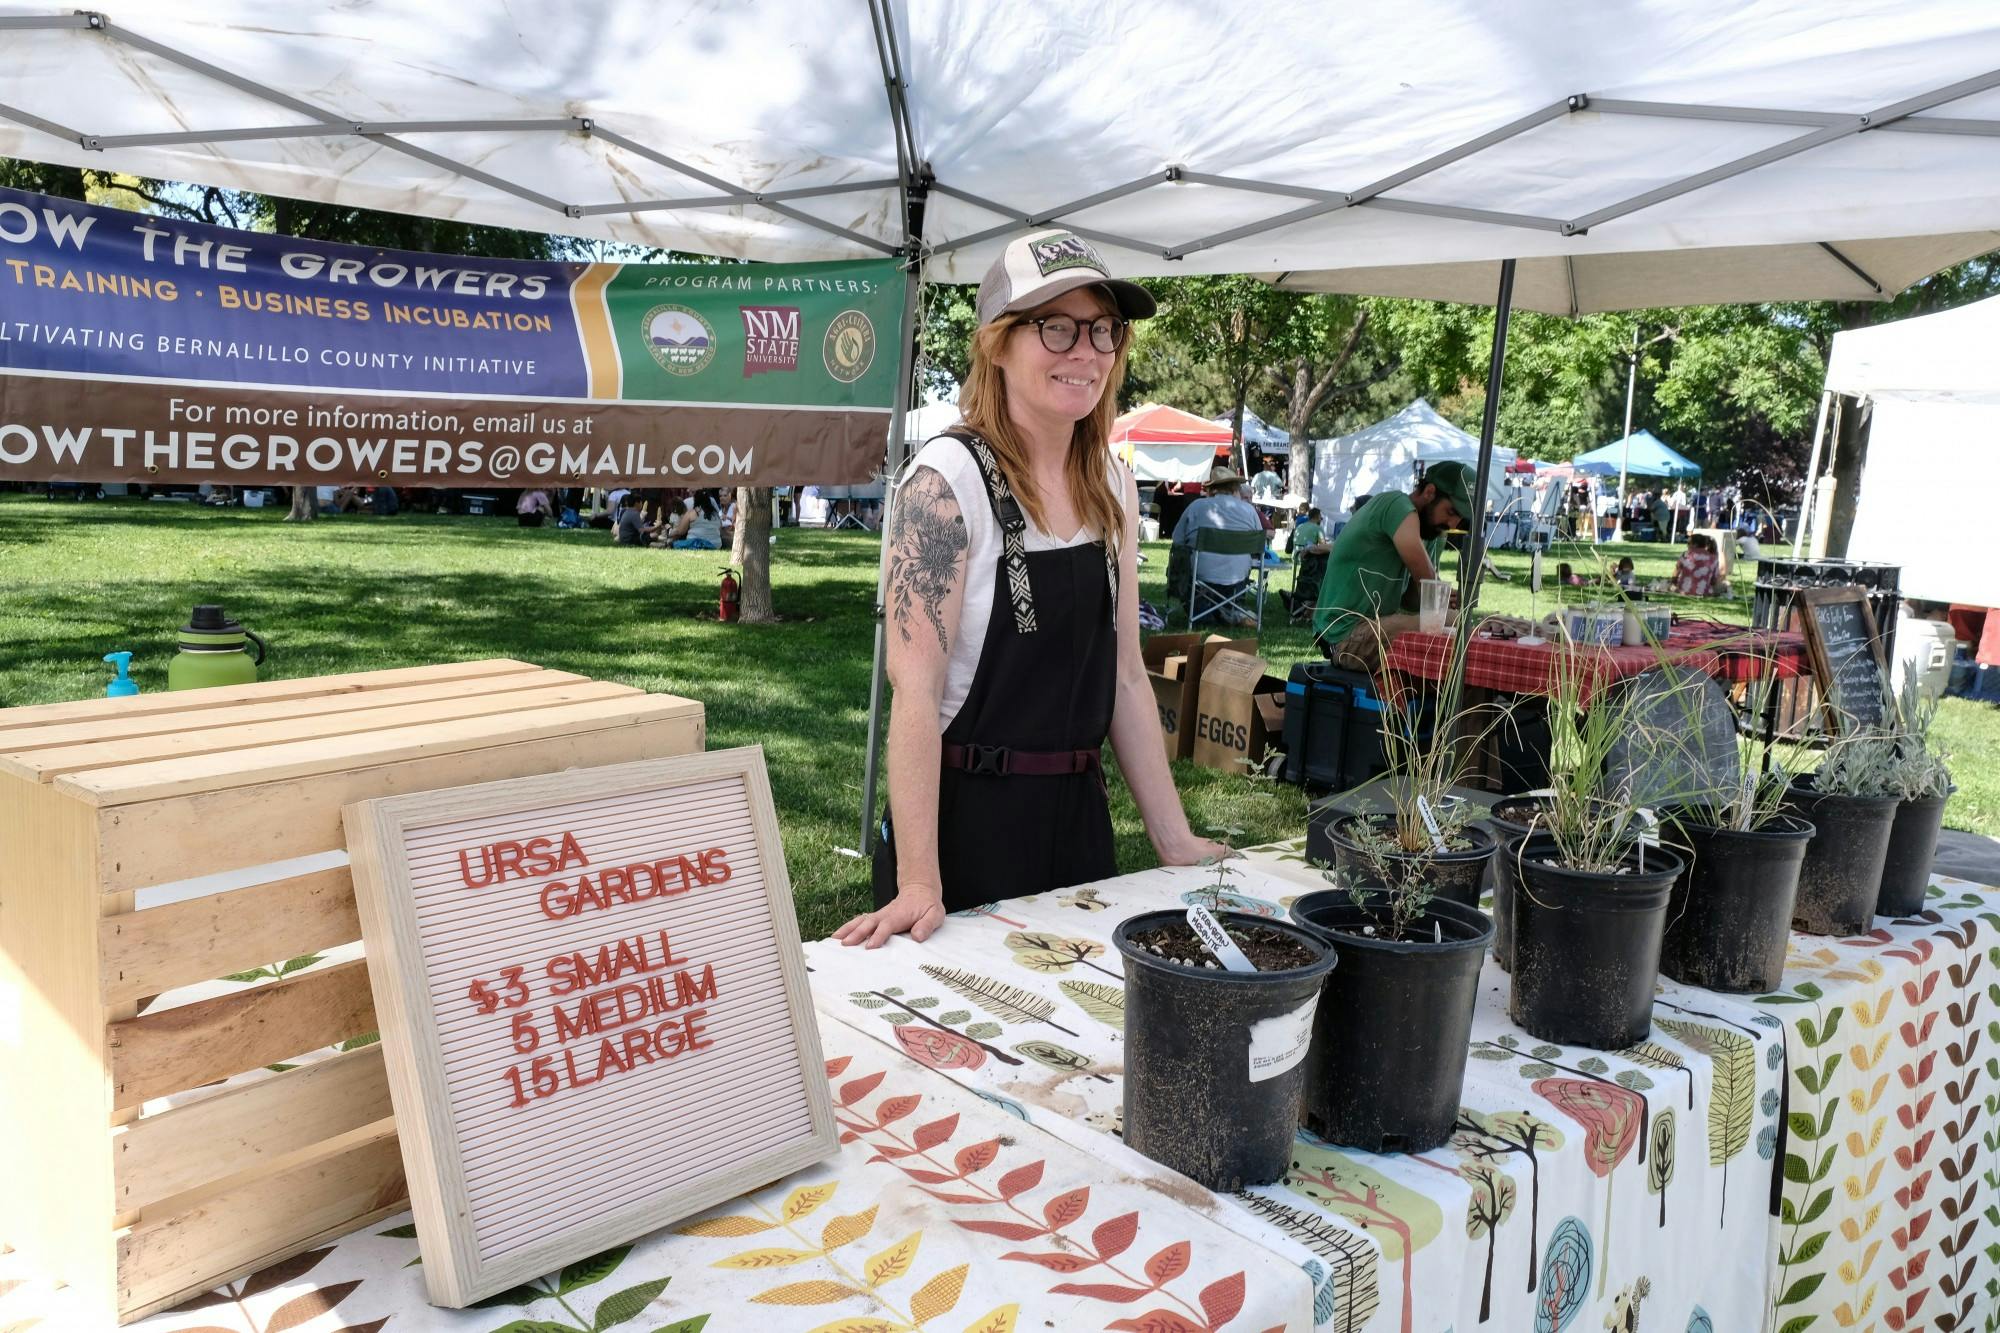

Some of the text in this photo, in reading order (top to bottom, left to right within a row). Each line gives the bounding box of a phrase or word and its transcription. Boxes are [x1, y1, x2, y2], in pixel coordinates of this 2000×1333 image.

[0, 202, 551, 300] OW THE GROWERS
[6, 258, 552, 333] TRAINING BUSINESS INCUBATION
[645, 275, 878, 295] PROGRAM PARTNERS:
[0, 321, 536, 376] LTIVATING BERNALILLO COUNTY INITIATIVE
[742, 310, 799, 340] NM
[747, 338, 799, 356] STATE
[747, 354, 796, 365] UNIVERSITY
[169, 398, 594, 435] For more information, email us at
[1198, 712, 1247, 751] EGGS
[458, 831, 590, 889] URSA
[540, 848, 732, 920] GARDENS
[468, 929, 688, 1015] $3 SMALL
[511, 962, 718, 1054] 5 MEDIUM
[504, 1009, 714, 1108] 15 LARGE
